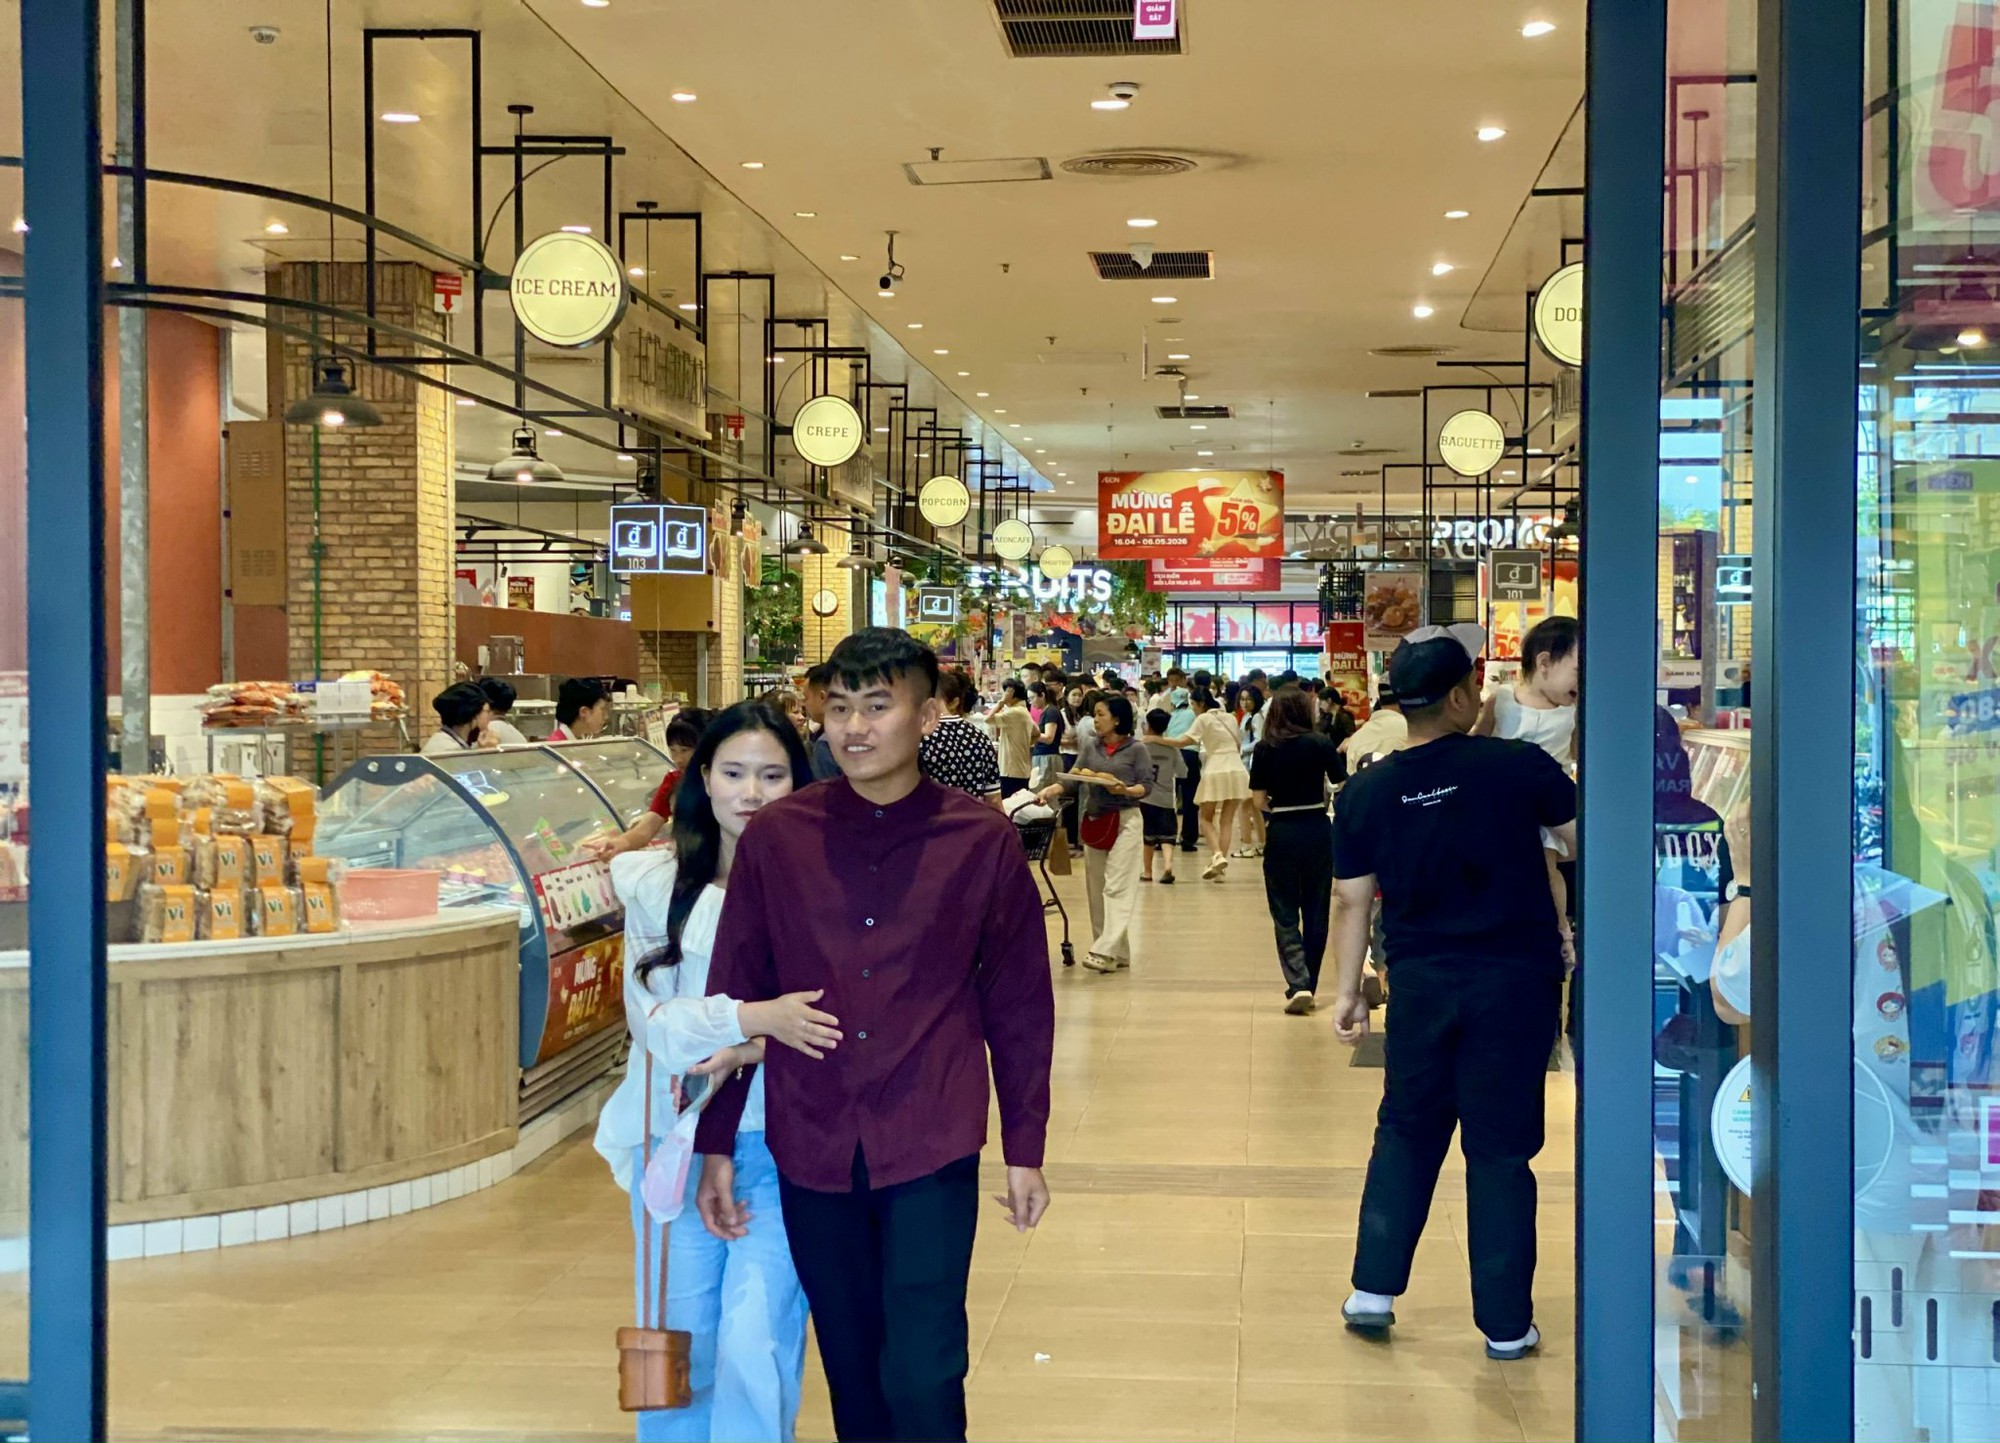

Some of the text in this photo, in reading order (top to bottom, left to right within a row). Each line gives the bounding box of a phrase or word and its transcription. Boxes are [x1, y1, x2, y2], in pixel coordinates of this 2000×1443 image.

[516, 279, 616, 297] ICE CREAM
[806, 425, 849, 438] CREPE
[1441, 436, 1503, 450] BAGUETTE
[921, 498, 967, 507] POPCORN
[1111, 488, 1173, 509] MỪNG
[1106, 501, 1195, 538] ĐẠI LỄ
[1142, 538, 1188, 546] 06.05.2026
[627, 557, 646, 569] 103
[1506, 589, 1523, 599] 101
[221, 852, 236, 866] Vi
[258, 851, 273, 866] Vi
[158, 863, 174, 876] Vi
[214, 901, 232, 917] Vi
[268, 899, 283, 913] Vi
[308, 897, 324, 910] Vi
[168, 905, 184, 920] Vi
